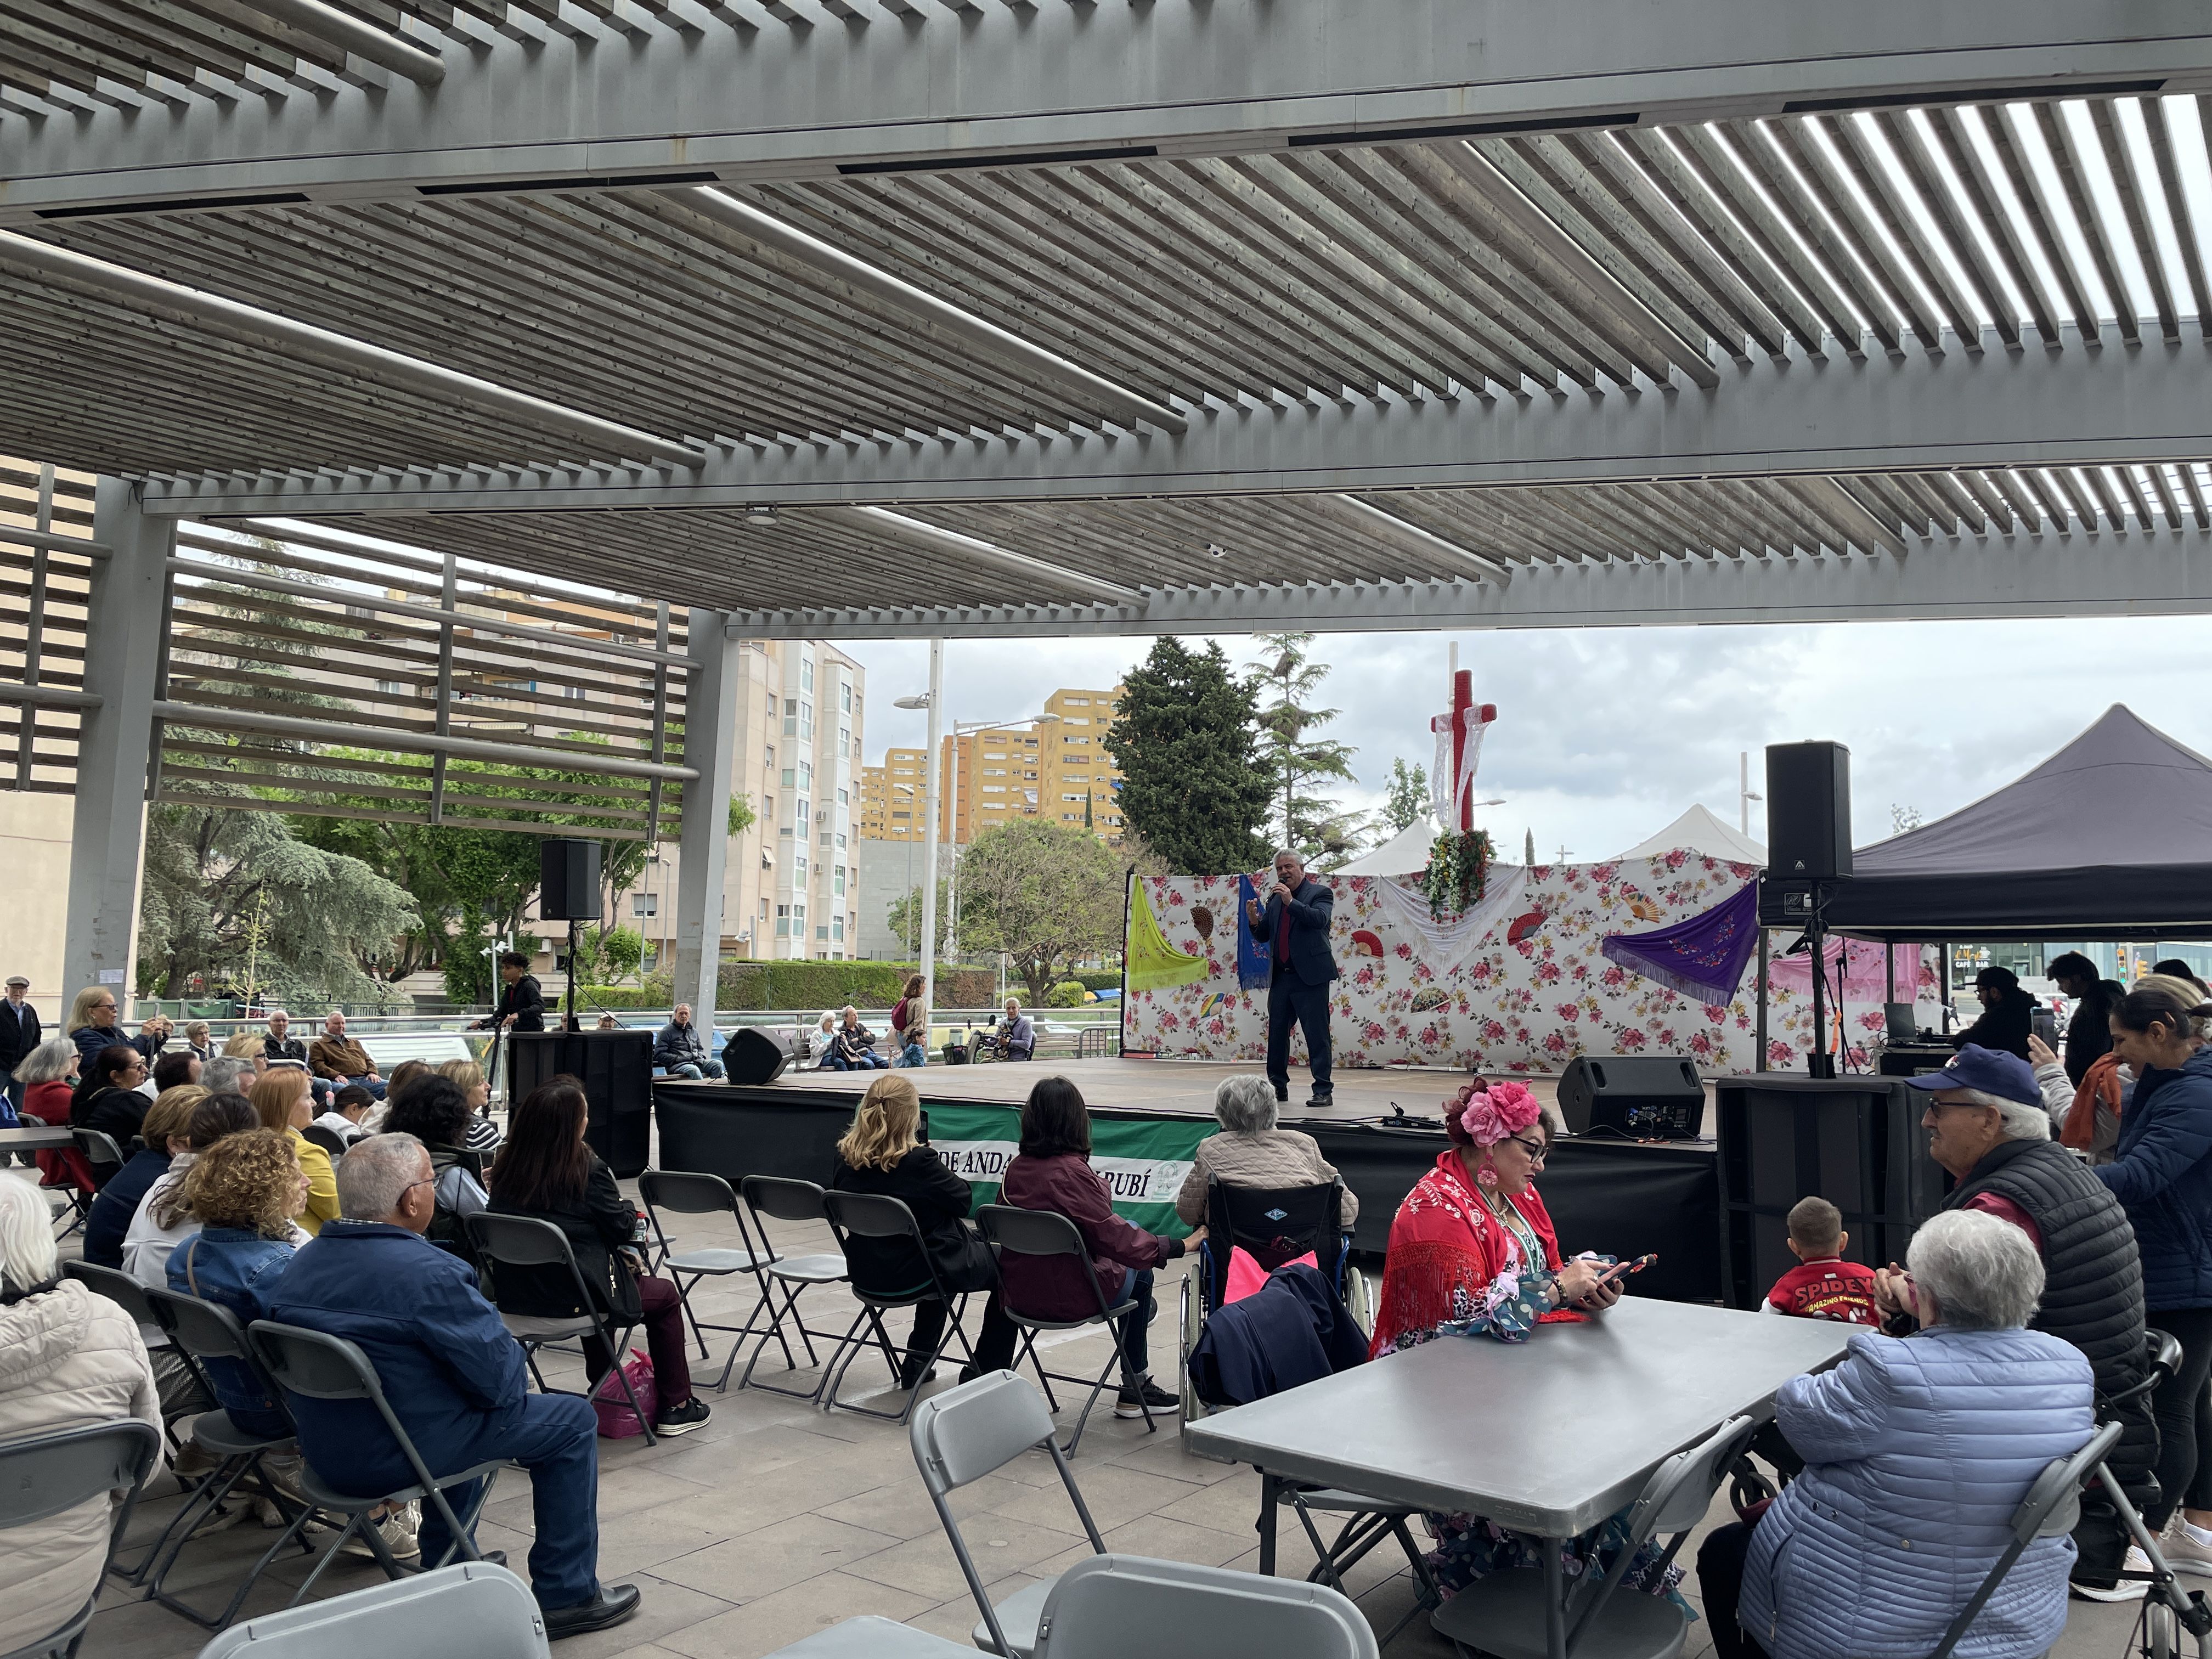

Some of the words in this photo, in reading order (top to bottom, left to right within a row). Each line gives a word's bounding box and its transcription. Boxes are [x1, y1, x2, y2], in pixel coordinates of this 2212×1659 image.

[939, 1151, 961, 1172] DE
[1795, 1278, 1874, 1310] SPIDEY
[1808, 1297, 1838, 1313] AMAZING
[1838, 1295, 1869, 1306] FRIENDS
